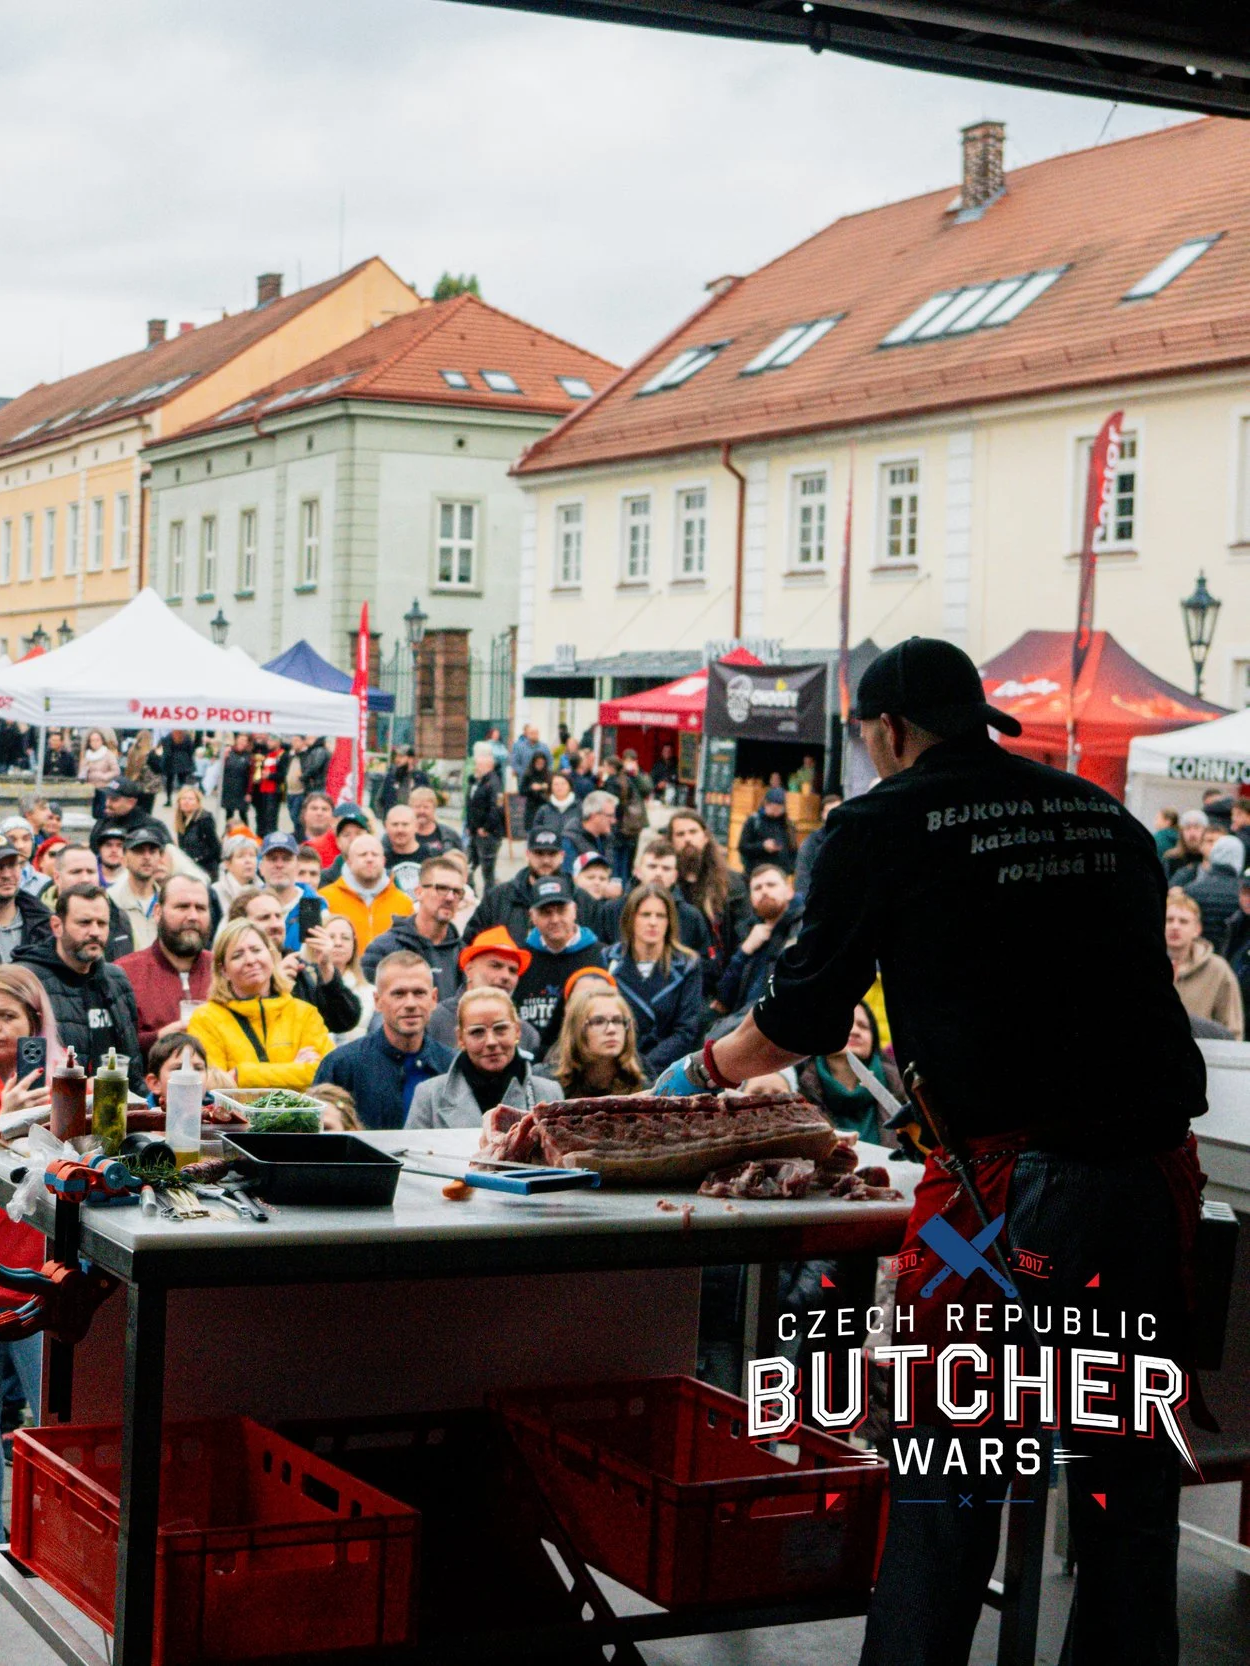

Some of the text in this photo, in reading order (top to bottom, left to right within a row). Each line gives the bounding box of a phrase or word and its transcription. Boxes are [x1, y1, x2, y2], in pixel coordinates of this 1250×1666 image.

[926, 800, 1035, 832] BEJKOVA
[970, 822, 1113, 854] každou ženu
